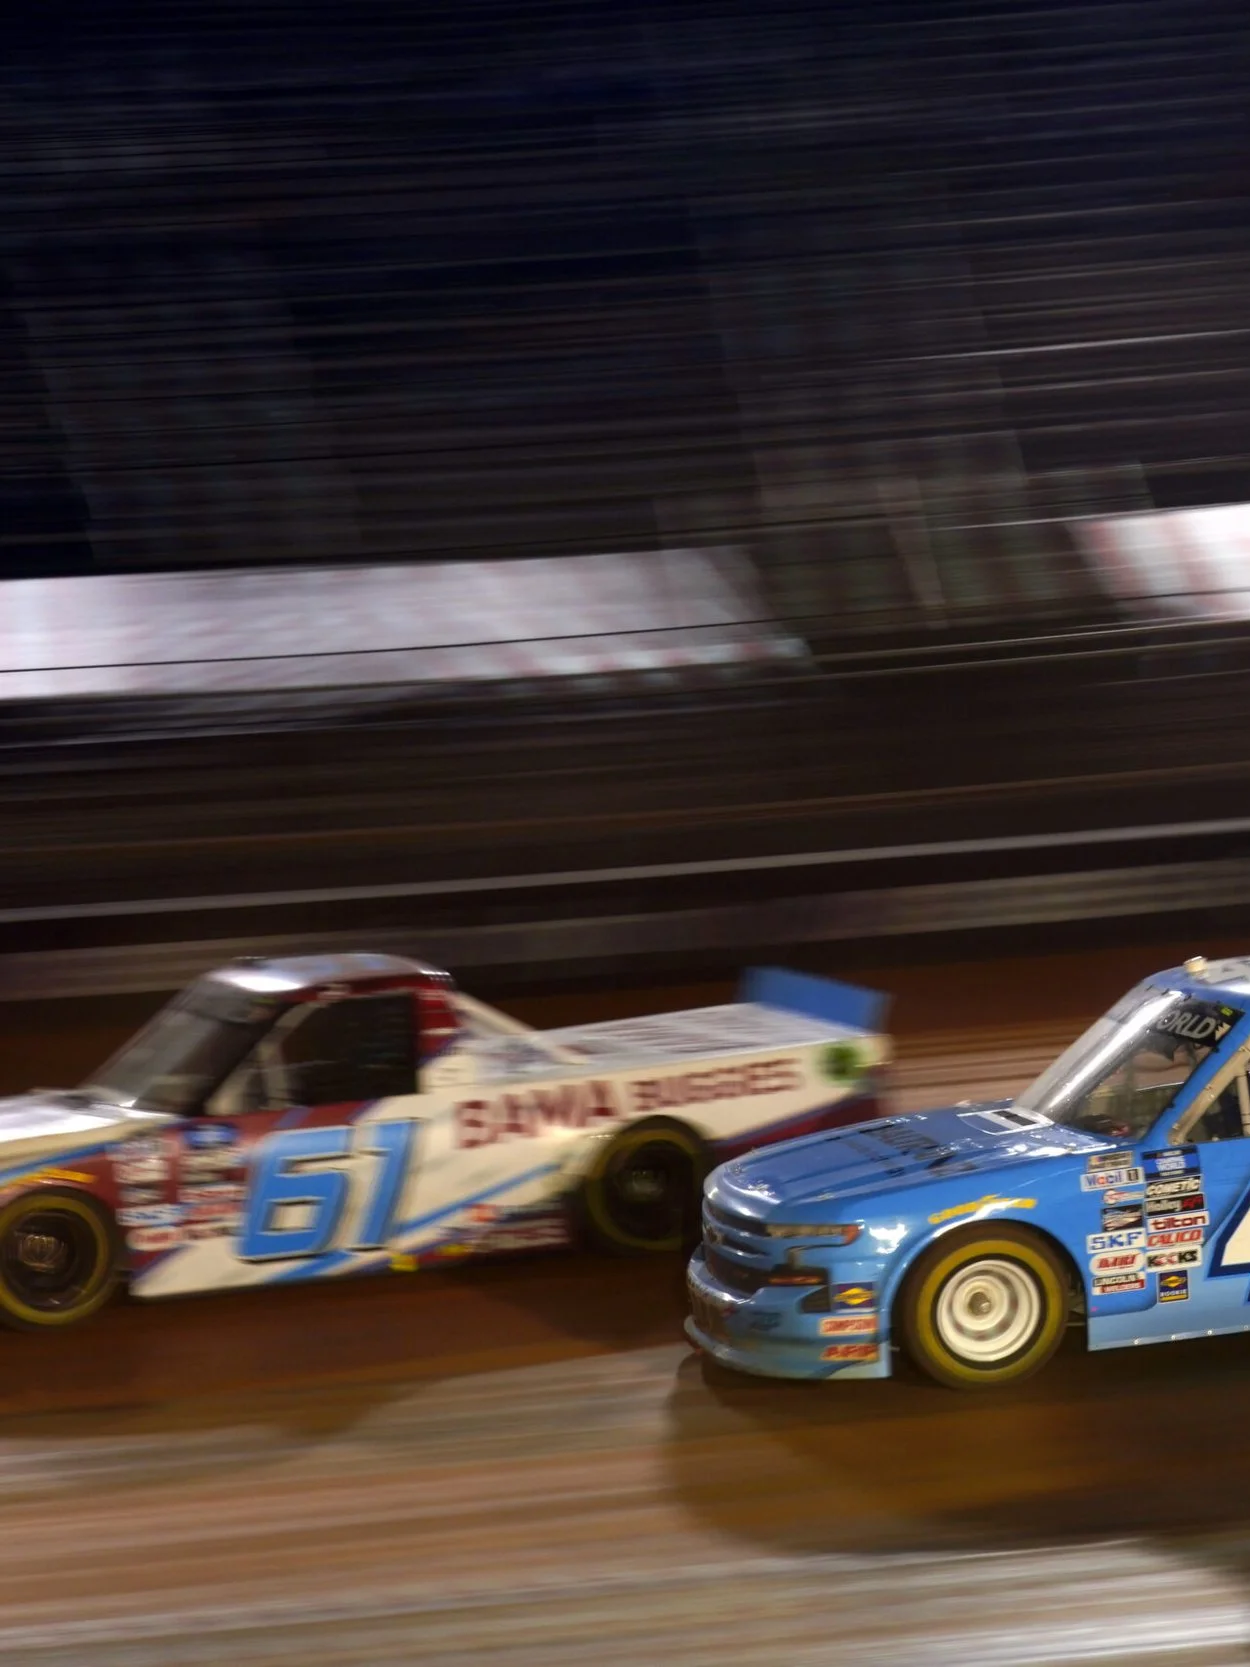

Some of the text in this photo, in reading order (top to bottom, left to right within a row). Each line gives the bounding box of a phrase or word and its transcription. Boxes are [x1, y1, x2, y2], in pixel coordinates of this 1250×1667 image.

[1156, 1010, 1217, 1039] ORLD
[233, 1118, 414, 1264] 61
[1150, 1215, 1206, 1230] tilton
[1090, 1231, 1143, 1251] SKF
[1146, 1229, 1202, 1248] CALICO
